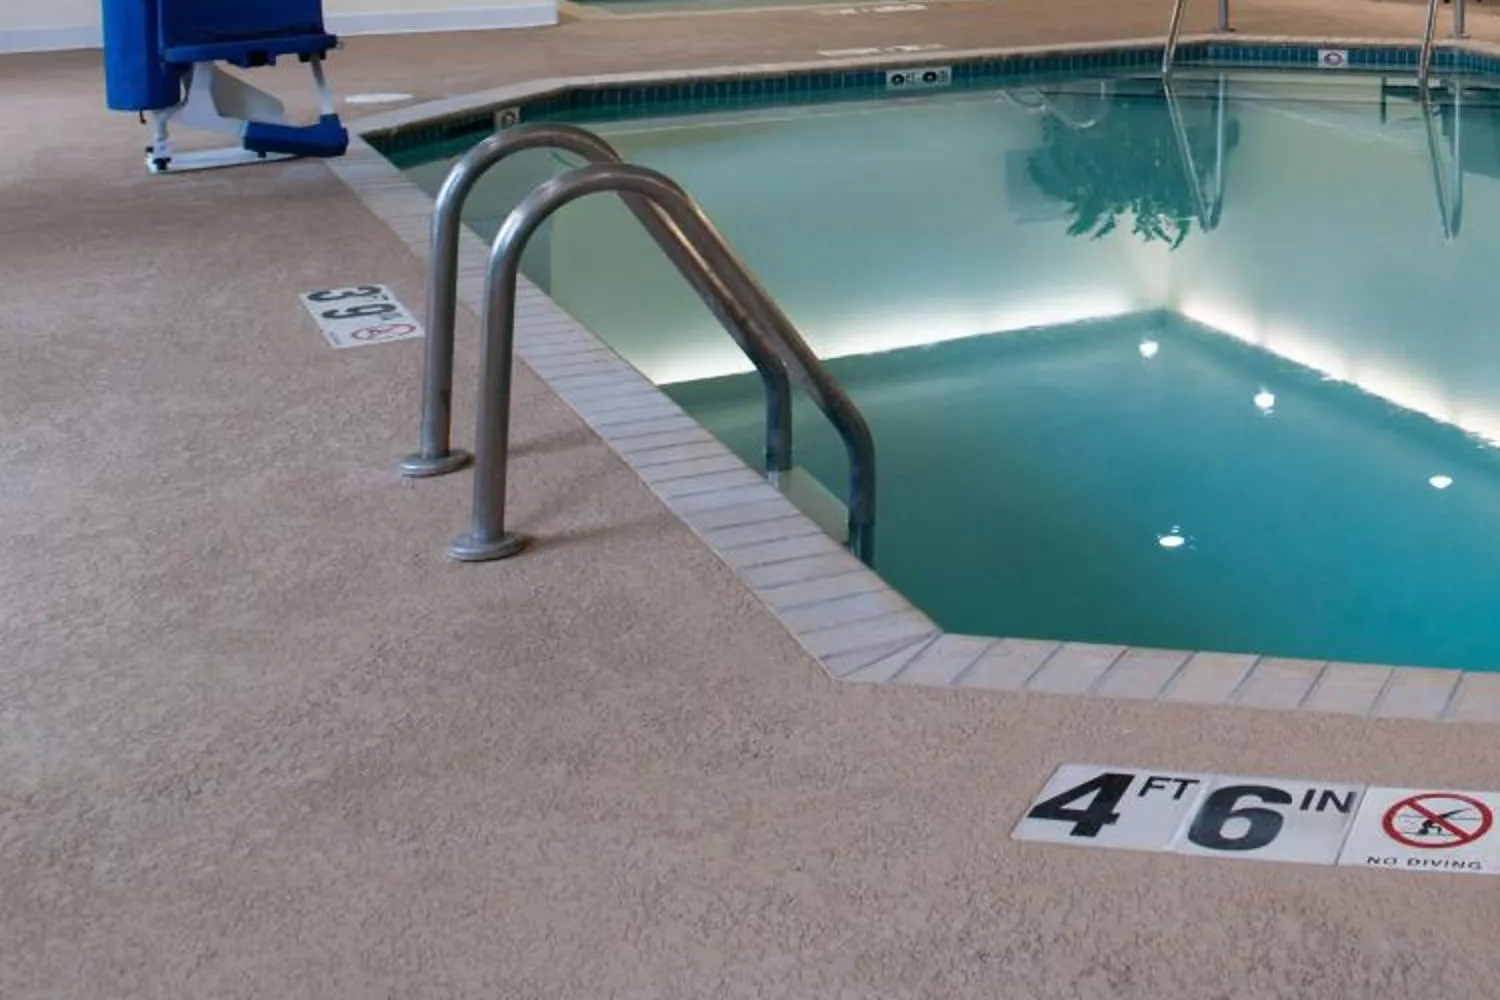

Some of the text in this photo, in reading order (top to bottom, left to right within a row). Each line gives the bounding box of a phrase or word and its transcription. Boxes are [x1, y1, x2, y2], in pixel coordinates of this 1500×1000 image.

[1027, 773, 1357, 851] 4 FT 6 IN
[1367, 856, 1483, 871] NO DIVING
